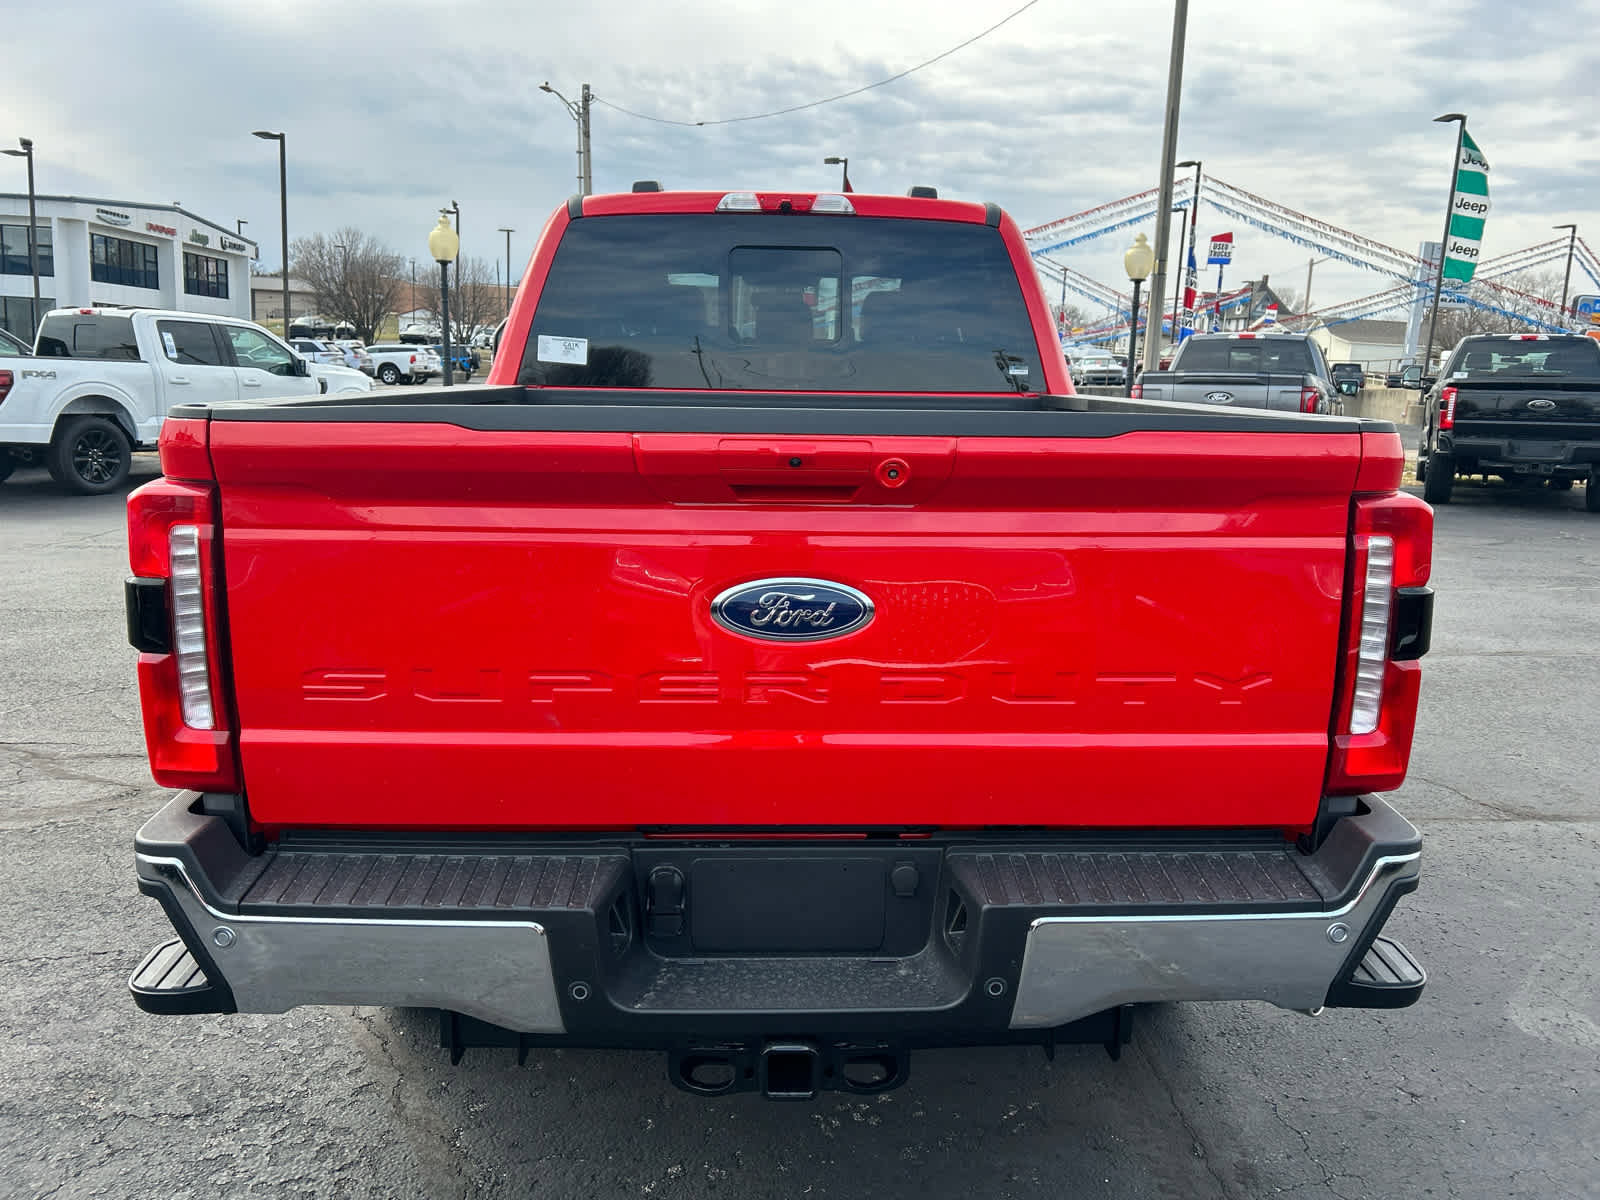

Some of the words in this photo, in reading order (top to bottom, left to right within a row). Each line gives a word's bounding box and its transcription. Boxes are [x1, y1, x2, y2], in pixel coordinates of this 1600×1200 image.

[1456, 197, 1488, 214] Jeep
[1212, 242, 1229, 250] USED
[1448, 241, 1479, 258] Jeep
[21, 370, 57, 380] FX4
[751, 591, 835, 627] Ford
[302, 668, 829, 704] SUPER
[880, 671, 1273, 705] DUTY
